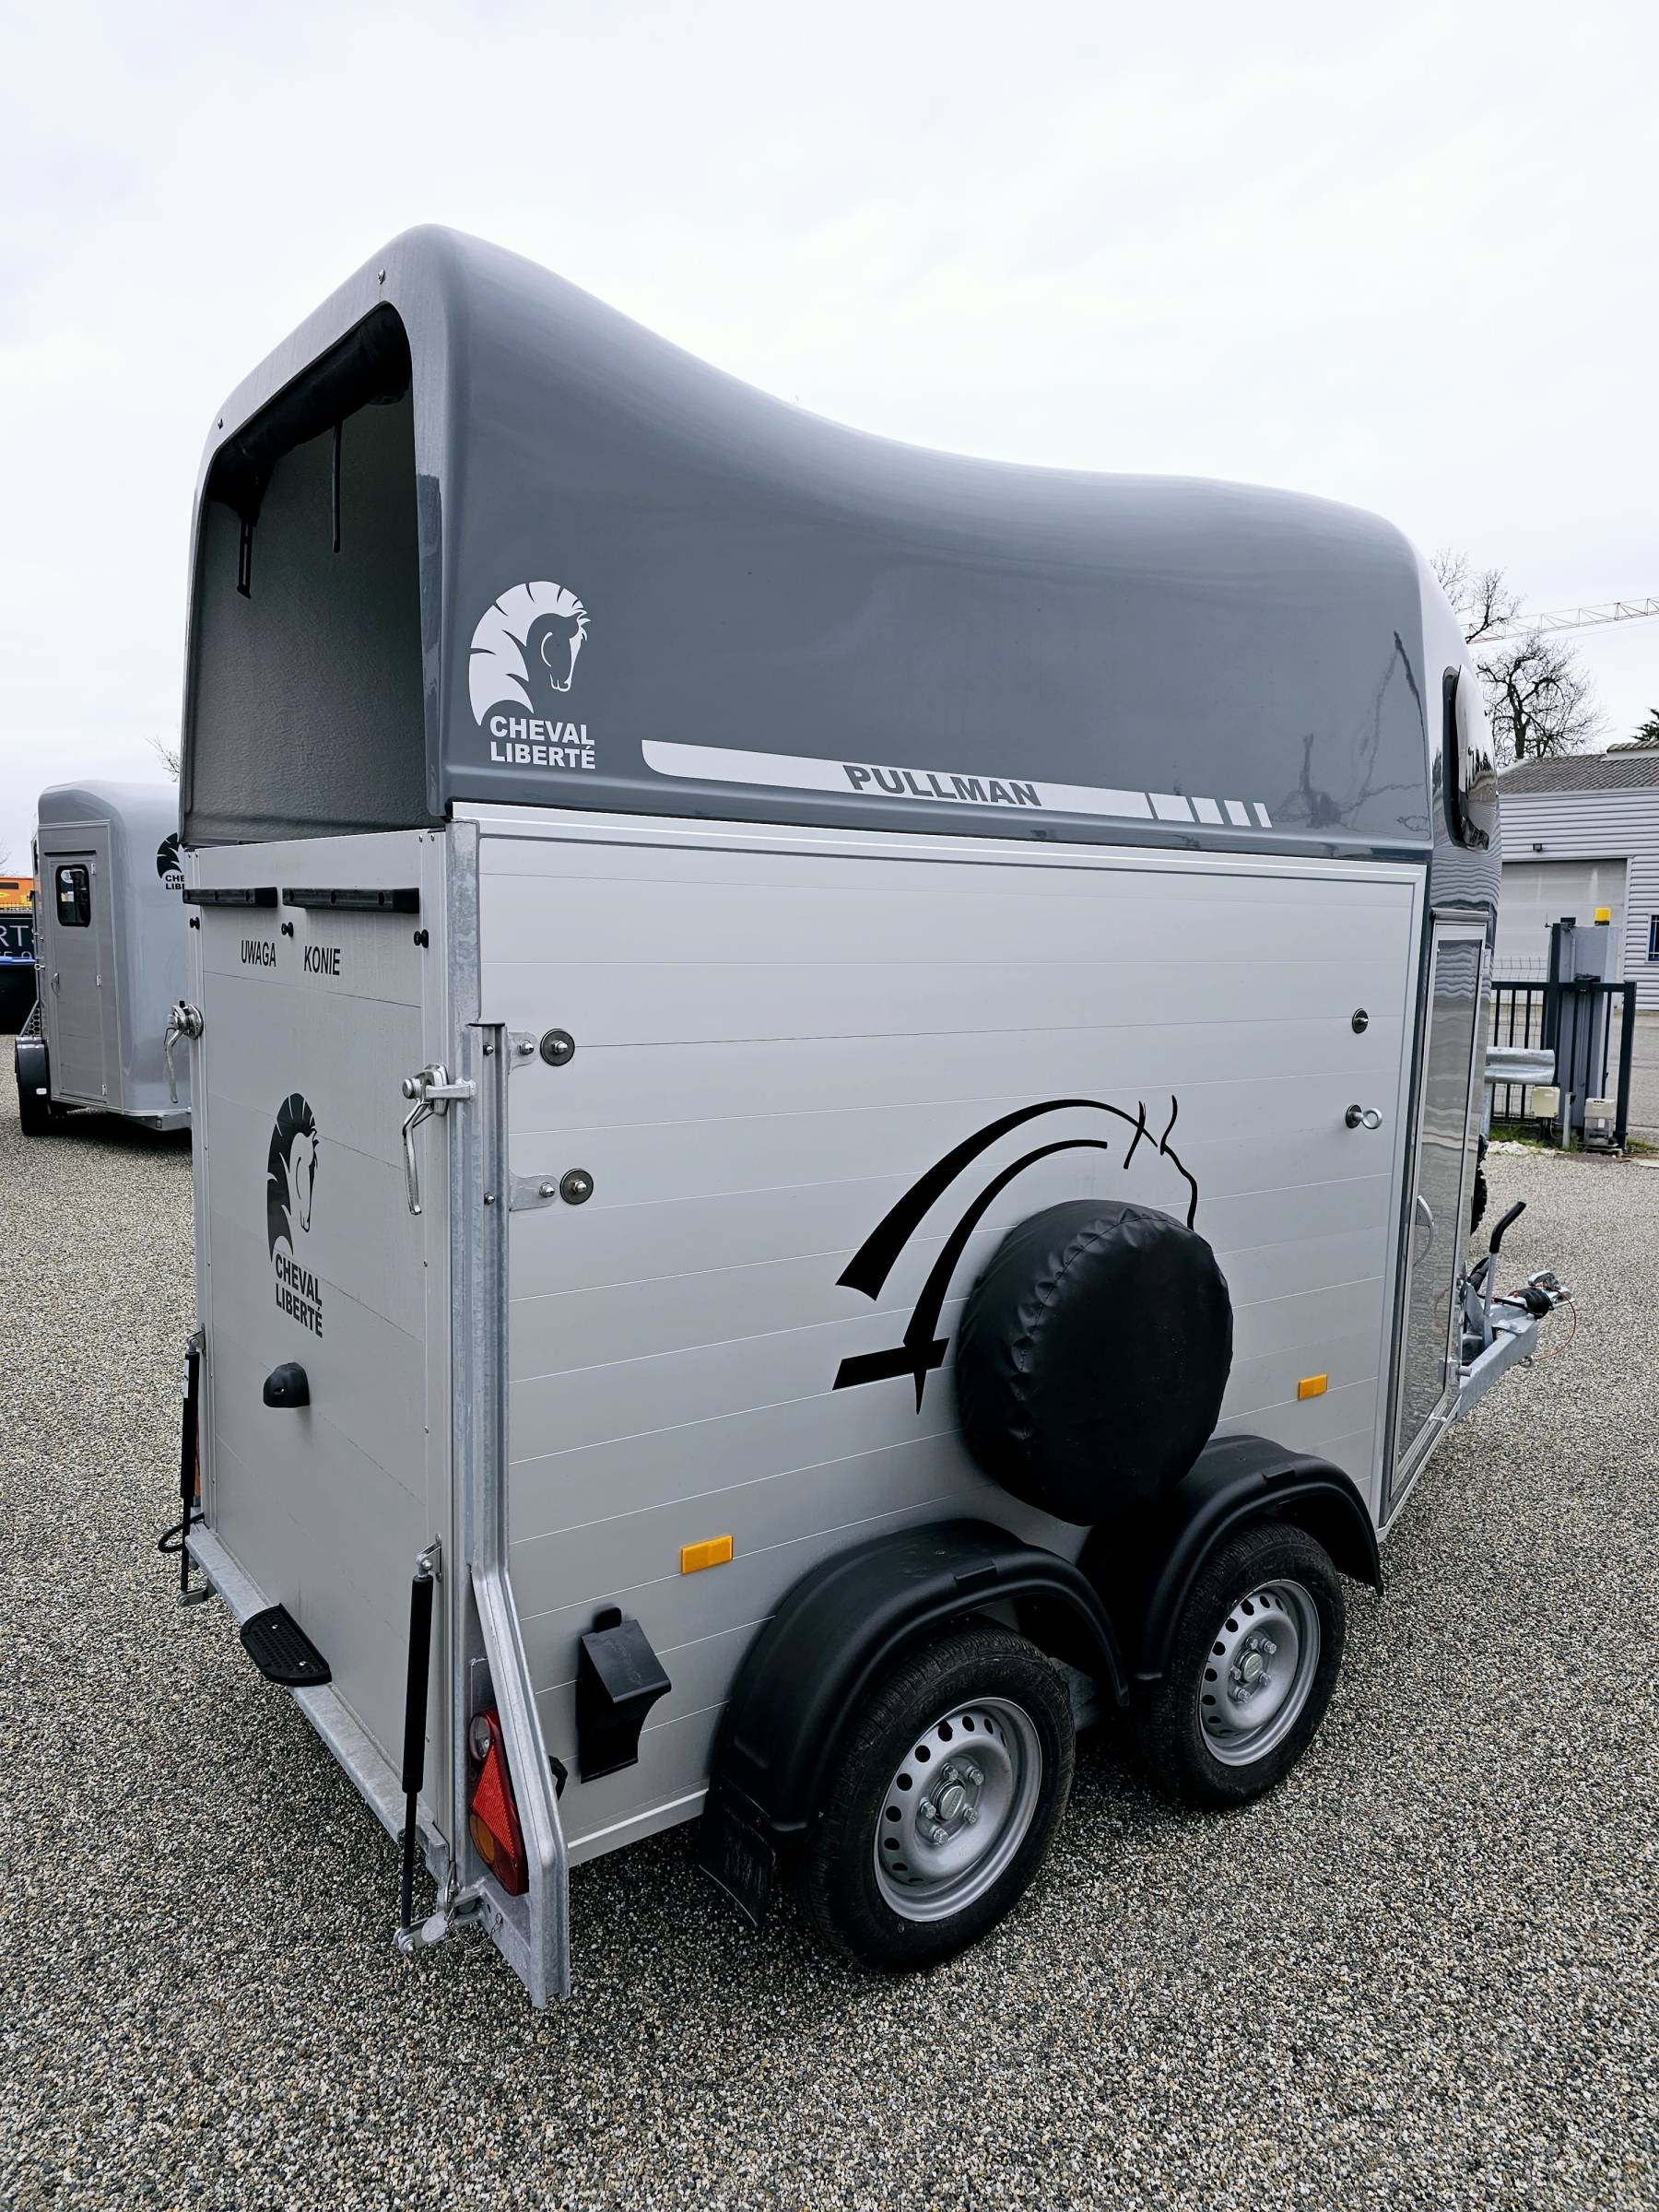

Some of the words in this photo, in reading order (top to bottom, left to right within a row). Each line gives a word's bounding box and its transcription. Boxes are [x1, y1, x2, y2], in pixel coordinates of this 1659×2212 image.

[489, 715, 595, 745] CHEVAL
[490, 741, 596, 770] LIBERTÉ
[842, 765, 1042, 806] PULLMAN
[241, 940, 276, 967] UWAGA
[304, 946, 341, 975] KONIE
[276, 1253, 323, 1307] CHEVAL
[276, 1282, 323, 1338] LIBERTÉ
